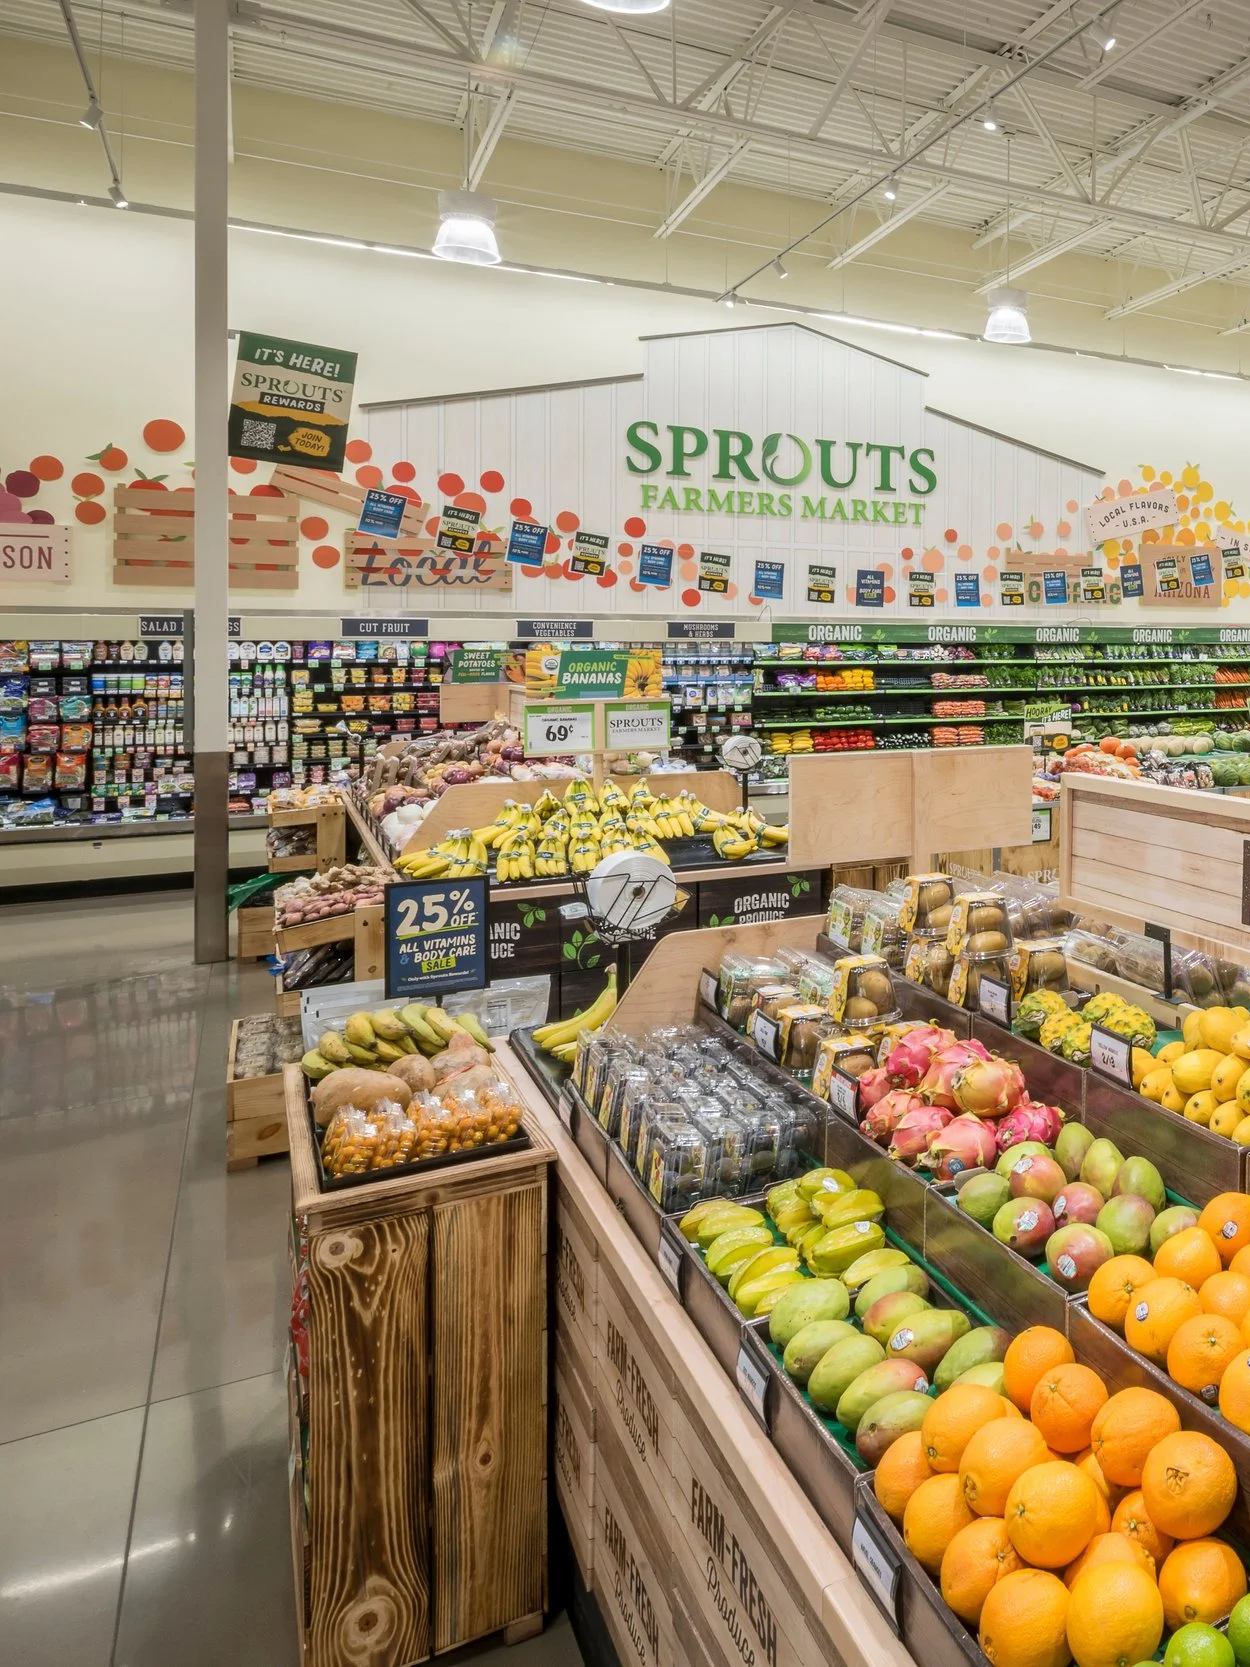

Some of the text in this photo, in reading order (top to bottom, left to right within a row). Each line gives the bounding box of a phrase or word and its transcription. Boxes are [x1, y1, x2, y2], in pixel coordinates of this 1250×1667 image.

[254, 348, 341, 378] IT'S HERE!
[240, 372, 344, 404] SPROUTS
[263, 394, 321, 413] REWARDS
[301, 431, 323, 443] JOIN
[295, 438, 325, 453] TODAY!
[626, 420, 937, 495] SPROUTS
[389, 497, 403, 506] OFF
[640, 484, 927, 525] FARMERS MARKET
[459, 511, 476, 521] HERE!
[1098, 501, 1170, 528] LOCAL FLAVORS
[1123, 516, 1150, 529] U.S.A.
[1229, 538, 1240, 548] IN
[361, 540, 493, 587] Local
[141, 621, 177, 632] SALAD
[359, 622, 410, 634] CUT FRUIT
[532, 622, 577, 630] CONVENIENCE
[535, 629, 575, 637] VEGETABLES
[683, 623, 719, 631] MUSHROOMS
[808, 625, 862, 641] ORGANIC
[928, 626, 976, 642] ORGANIC
[1036, 627, 1080, 642] ORGANIC
[1133, 629, 1172, 643] ORGANIC
[464, 651, 490, 660] SWEET
[458, 660, 496, 668] POTATOES
[568, 661, 617, 672] ORGANIC
[562, 672, 622, 684] BANANAS
[1025, 706, 1052, 718] HOORAY
[1052, 708, 1072, 721] HERE!
[609, 717, 663, 728] SPROUTS
[545, 724, 574, 742] 69¢
[734, 892, 790, 914] ORGANIC
[395, 888, 475, 936] 25%
[399, 934, 476, 954] ALL VITAMINS
[400, 945, 477, 965] & BODY CARE
[426, 958, 452, 971] SALE
[607, 1320, 659, 1457] FARM-FRESH
[616, 1379, 647, 1462] Produce
[692, 1477, 777, 1661] FARM-FRESH
[604, 1505, 658, 1664] FARM-FRESH
[615, 1570, 646, 1666] Produce
[706, 1555, 755, 1667] Produce
